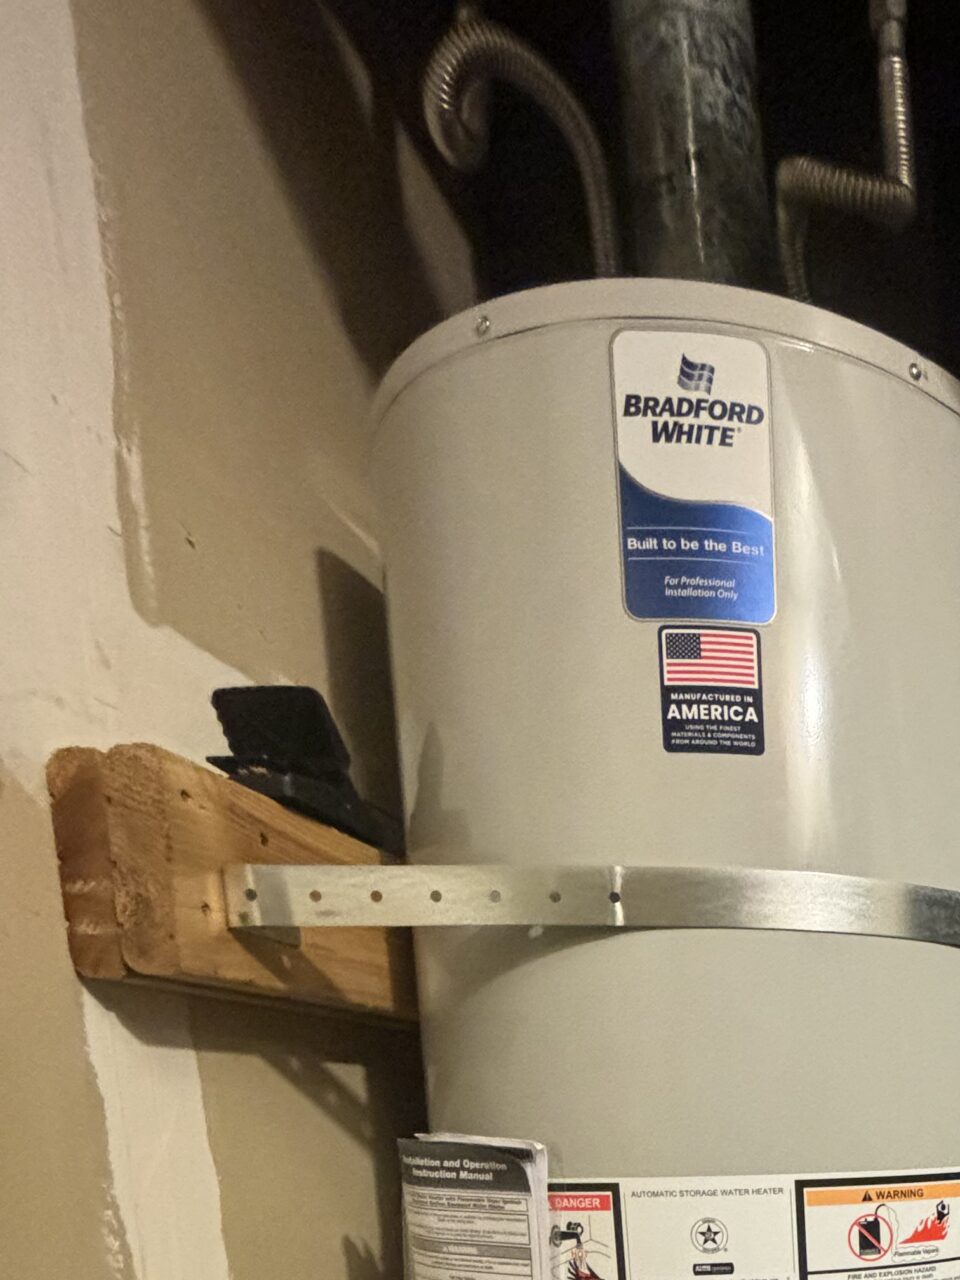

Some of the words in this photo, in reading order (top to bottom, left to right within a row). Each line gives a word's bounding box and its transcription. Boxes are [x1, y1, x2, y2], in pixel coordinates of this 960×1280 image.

[623, 394, 764, 425] BRADFORD
[652, 420, 735, 447] WHITE
[627, 537, 658, 550] Built
[662, 539, 676, 550] to
[681, 538, 699, 550] be
[704, 539, 726, 552] the
[732, 542, 764, 556] Best
[664, 576, 678, 585] For
[681, 576, 735, 587] Professional
[665, 588, 715, 598] Installation
[717, 590, 738, 600] Only
[671, 693, 741, 702] MANUFACTURED
[667, 704, 758, 722] AMERICA
[412, 1168, 456, 1178] Instruction
[459, 1171, 493, 1181] Manual
[631, 1190, 677, 1198] AUTOMATIC
[876, 1189, 924, 1200] WARNING
[555, 1197, 601, 1209] DANGER
[879, 1269, 912, 1277] EXPLOSION
[914, 1266, 936, 1274] HAZARD
